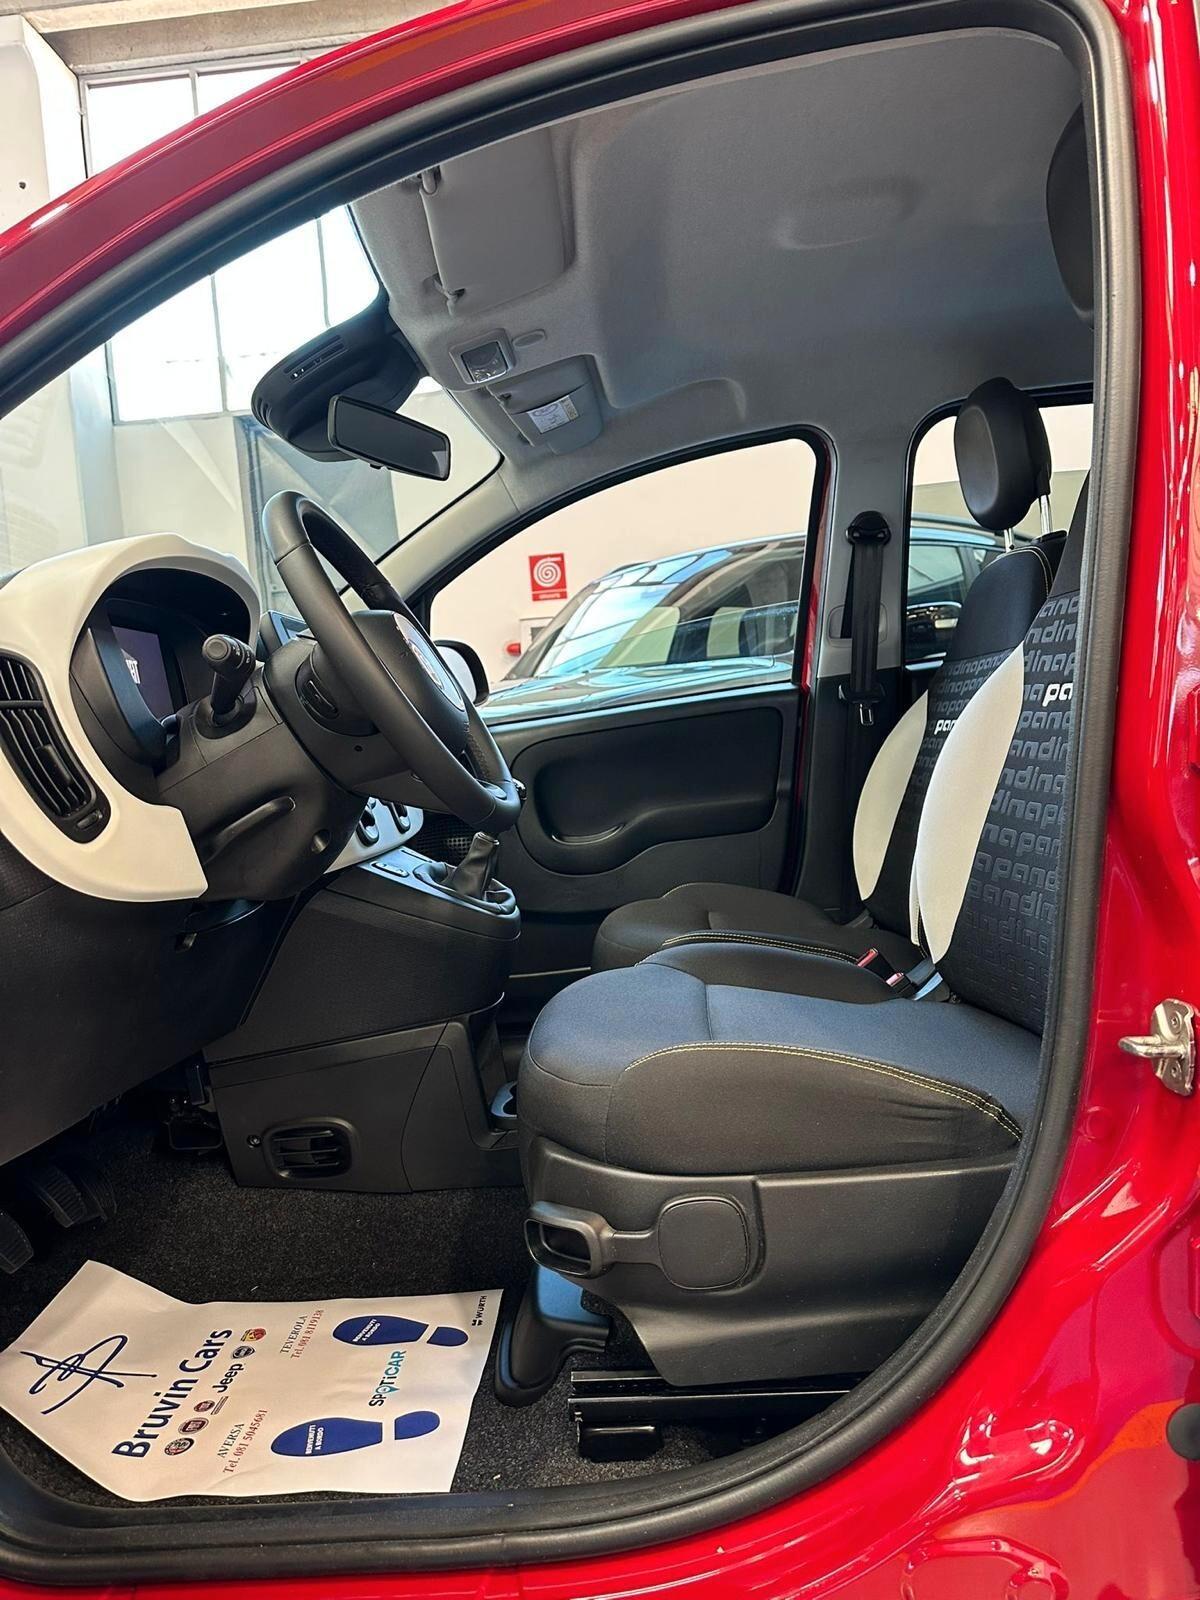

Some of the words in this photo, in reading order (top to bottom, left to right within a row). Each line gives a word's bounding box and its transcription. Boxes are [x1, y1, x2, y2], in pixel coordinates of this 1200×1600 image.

[280, 1314, 308, 1354] TEVEROLA
[111, 1378, 199, 1458] Bruvin
[178, 1329, 233, 1373] Cars
[212, 1363, 245, 1393] Jeep
[217, 1422, 245, 1458] AVERSA
[233, 1442, 249, 1458] 081
